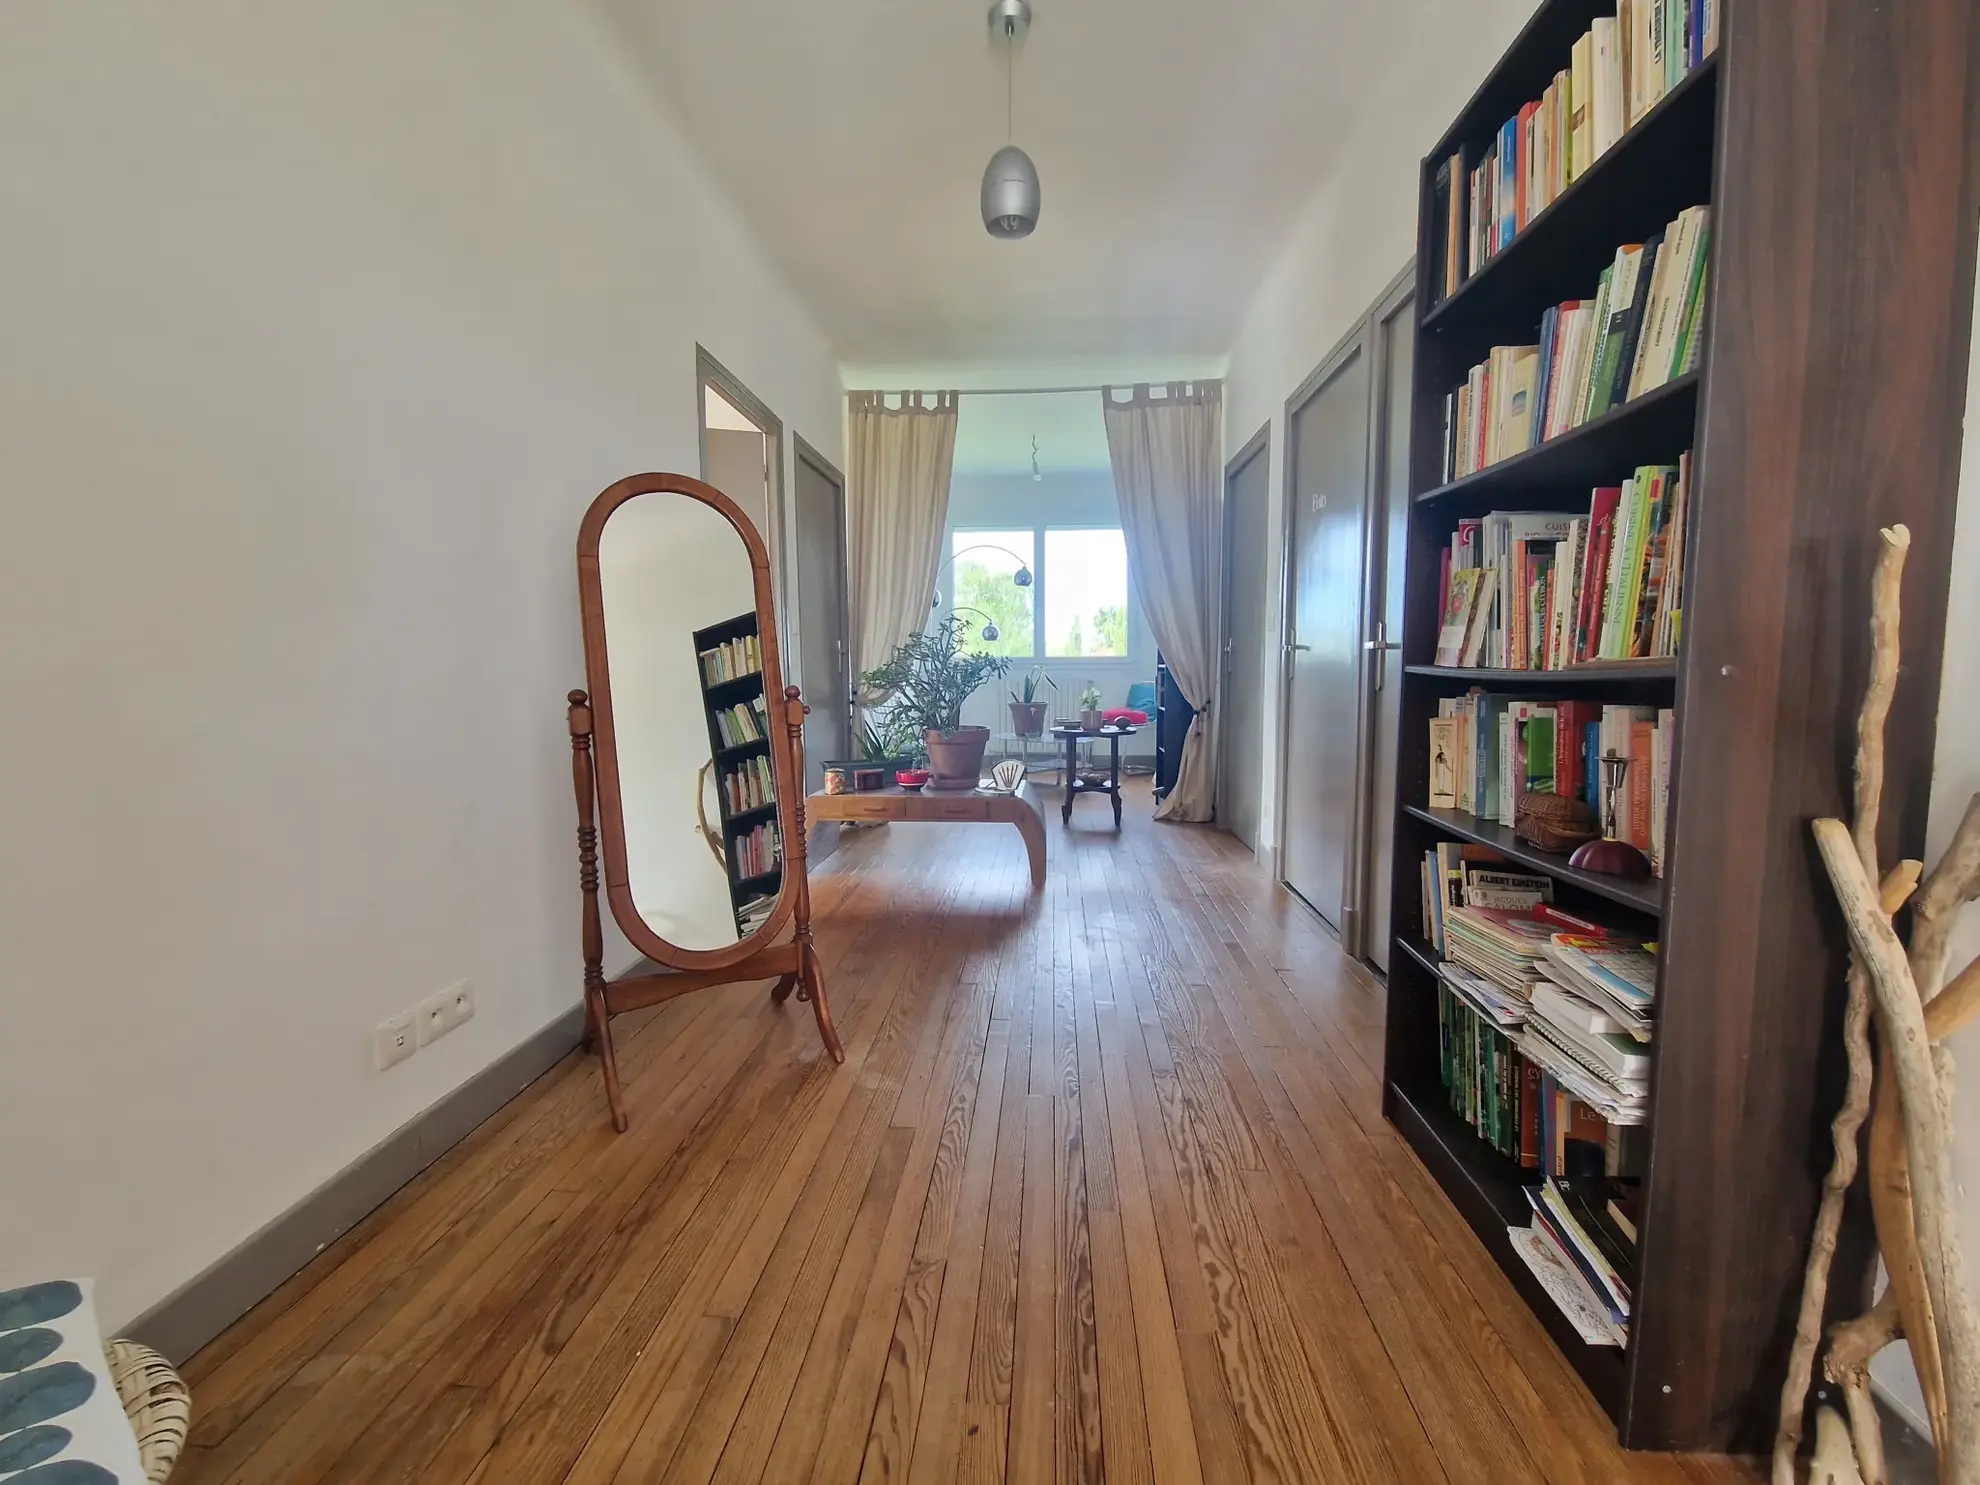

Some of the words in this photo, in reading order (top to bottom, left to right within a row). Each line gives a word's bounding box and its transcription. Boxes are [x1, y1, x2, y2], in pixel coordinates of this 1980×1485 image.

[1479, 874, 1510, 885] ALBERT
[1511, 878, 1550, 889] EINSTEIN
[1492, 896, 1528, 904] JACQUES
